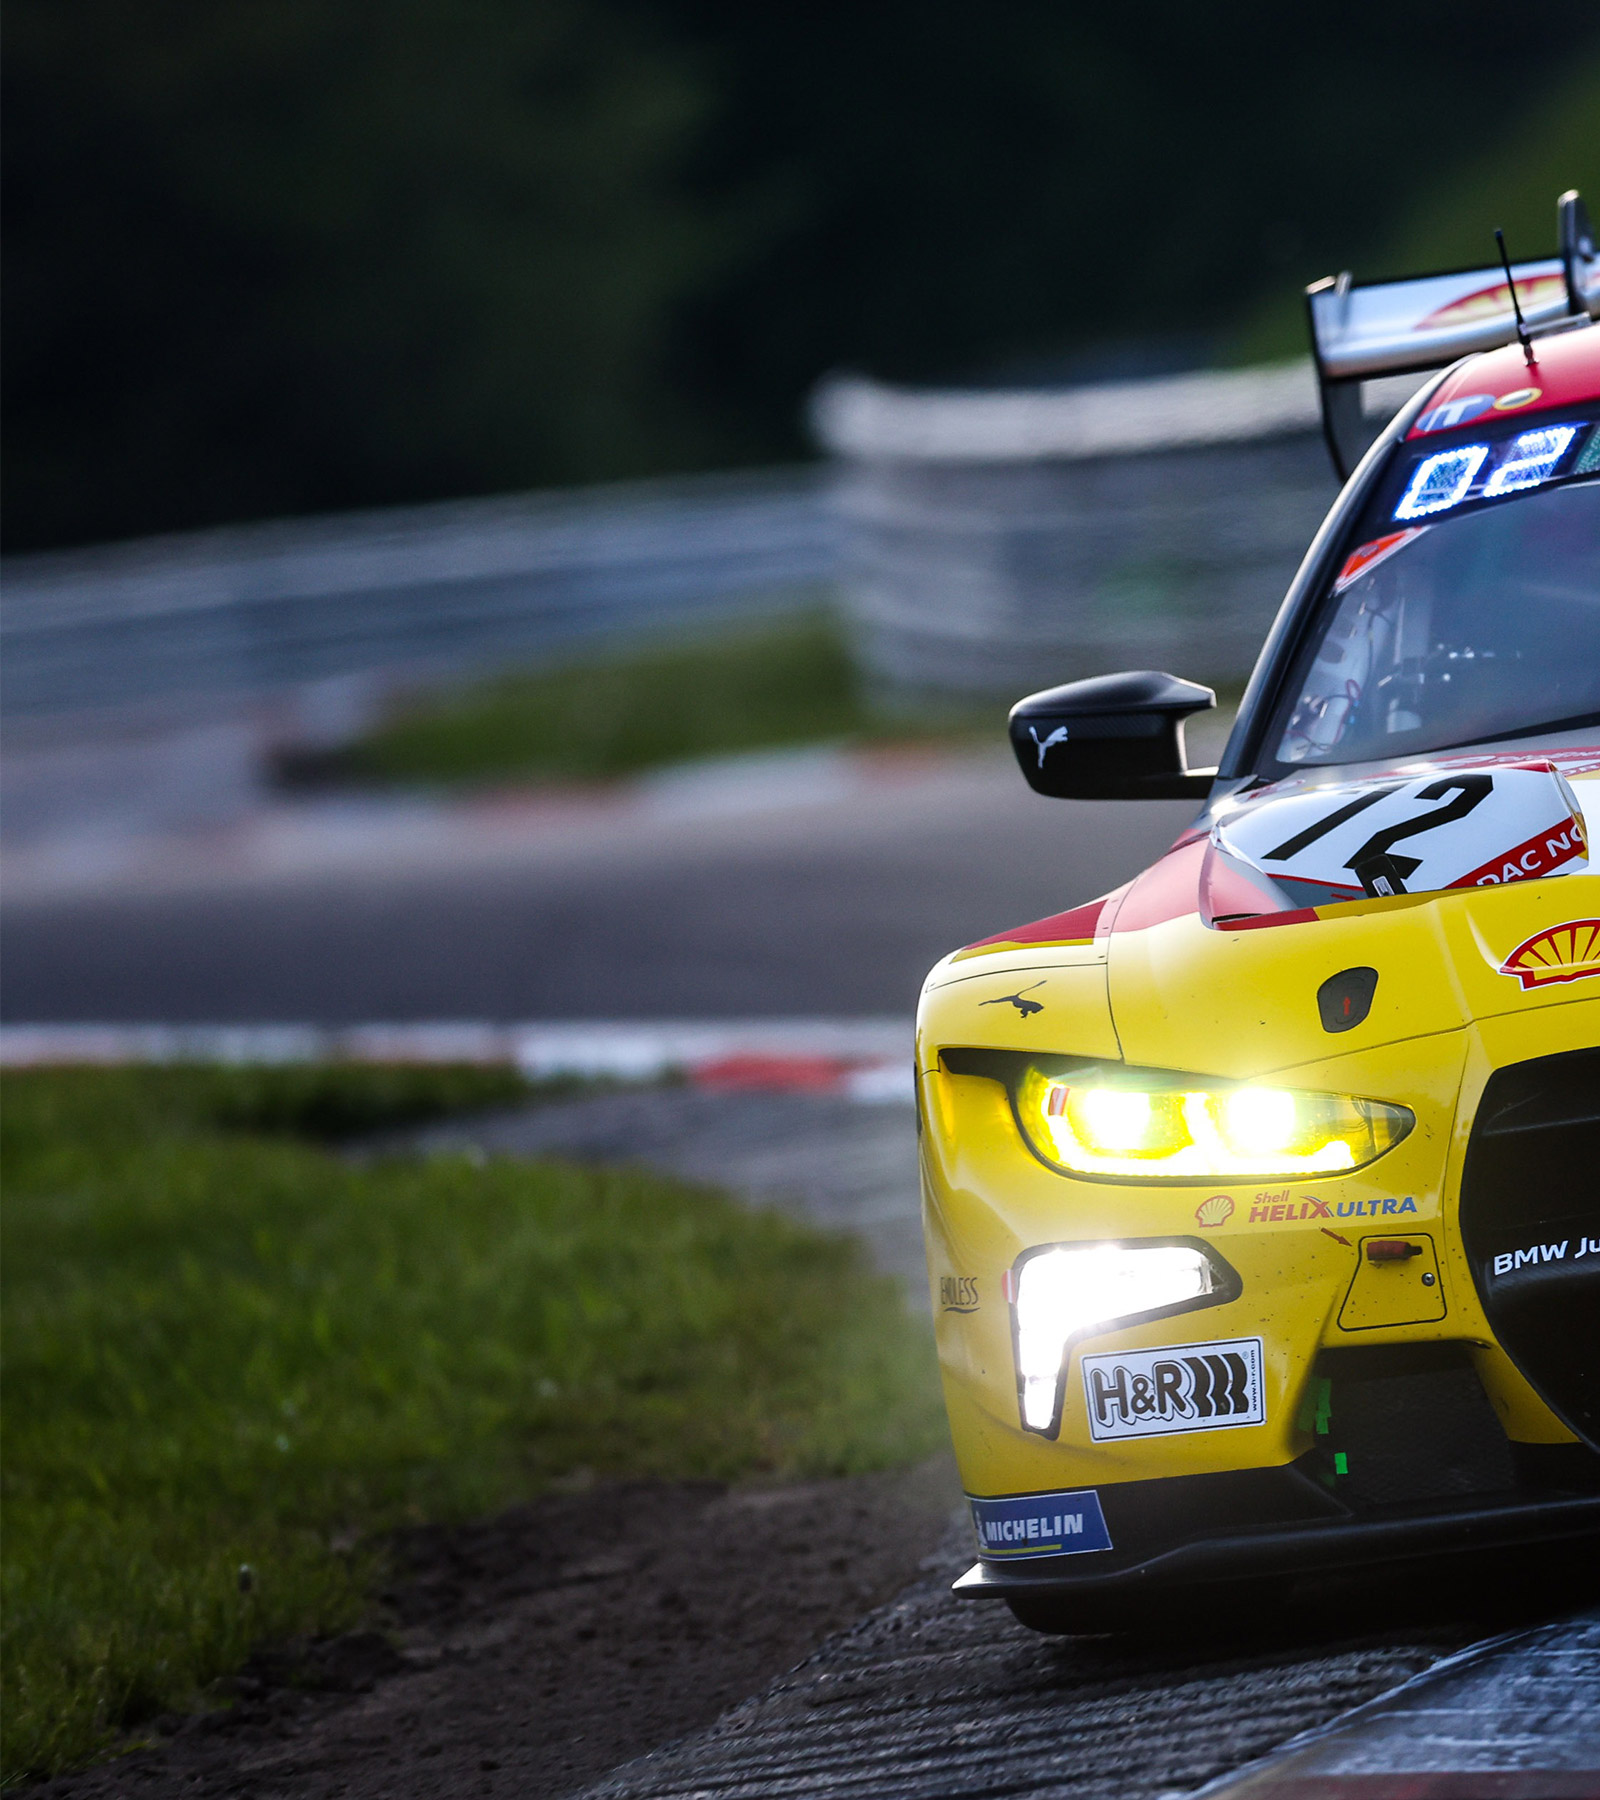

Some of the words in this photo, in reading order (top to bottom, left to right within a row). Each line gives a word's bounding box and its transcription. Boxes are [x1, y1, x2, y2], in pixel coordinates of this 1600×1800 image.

[1248, 1196, 1335, 1223] HELIX
[1336, 1196, 1418, 1217] ULTRA
[1253, 1190, 1290, 1204] Shell
[1493, 1240, 1569, 1276] BMW
[1093, 1362, 1188, 1422] H&R
[985, 1512, 1084, 1543] MICHELIN
